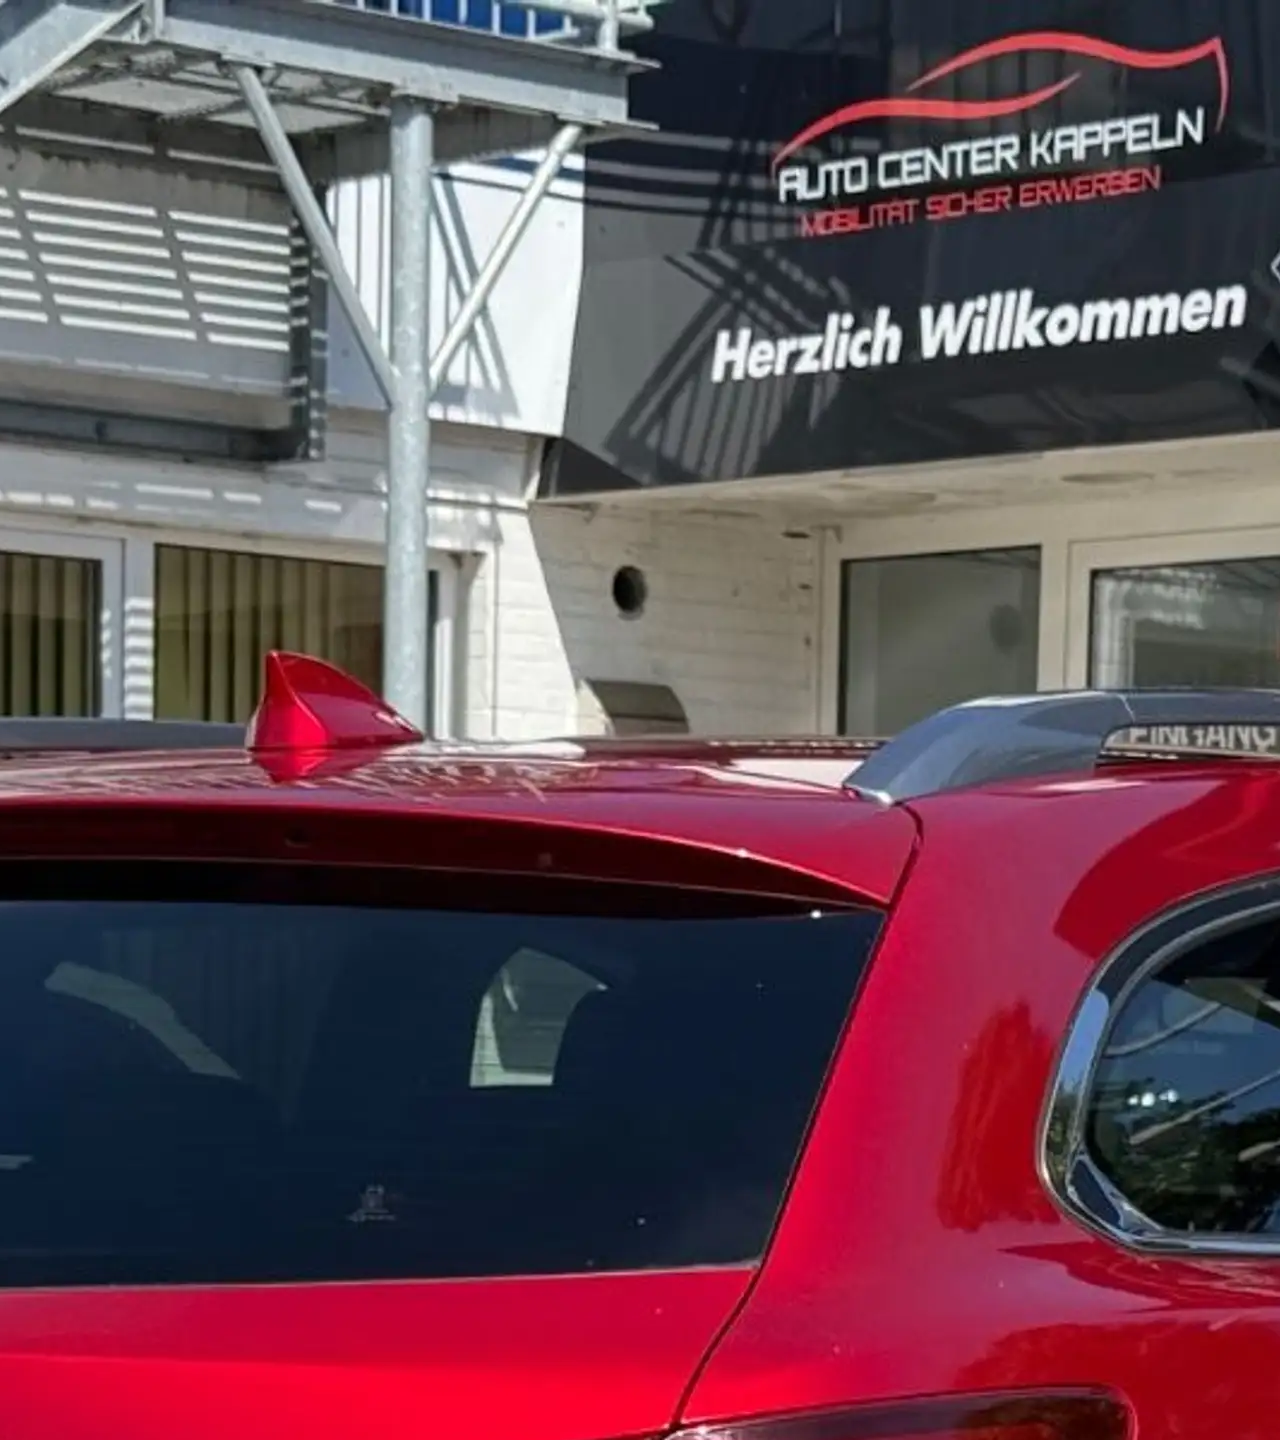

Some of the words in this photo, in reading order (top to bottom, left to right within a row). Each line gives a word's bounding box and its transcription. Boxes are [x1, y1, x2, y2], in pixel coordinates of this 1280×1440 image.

[778, 161, 869, 202] AUTO
[878, 136, 1021, 187] CENTER
[1030, 107, 1205, 166] KAPPELN
[799, 198, 919, 238] MOBILITÄT
[925, 185, 1012, 221] SICHER
[1019, 166, 1162, 208] ERWERBEN
[711, 305, 903, 383] Herzlich
[920, 284, 1247, 359] Willkommen
